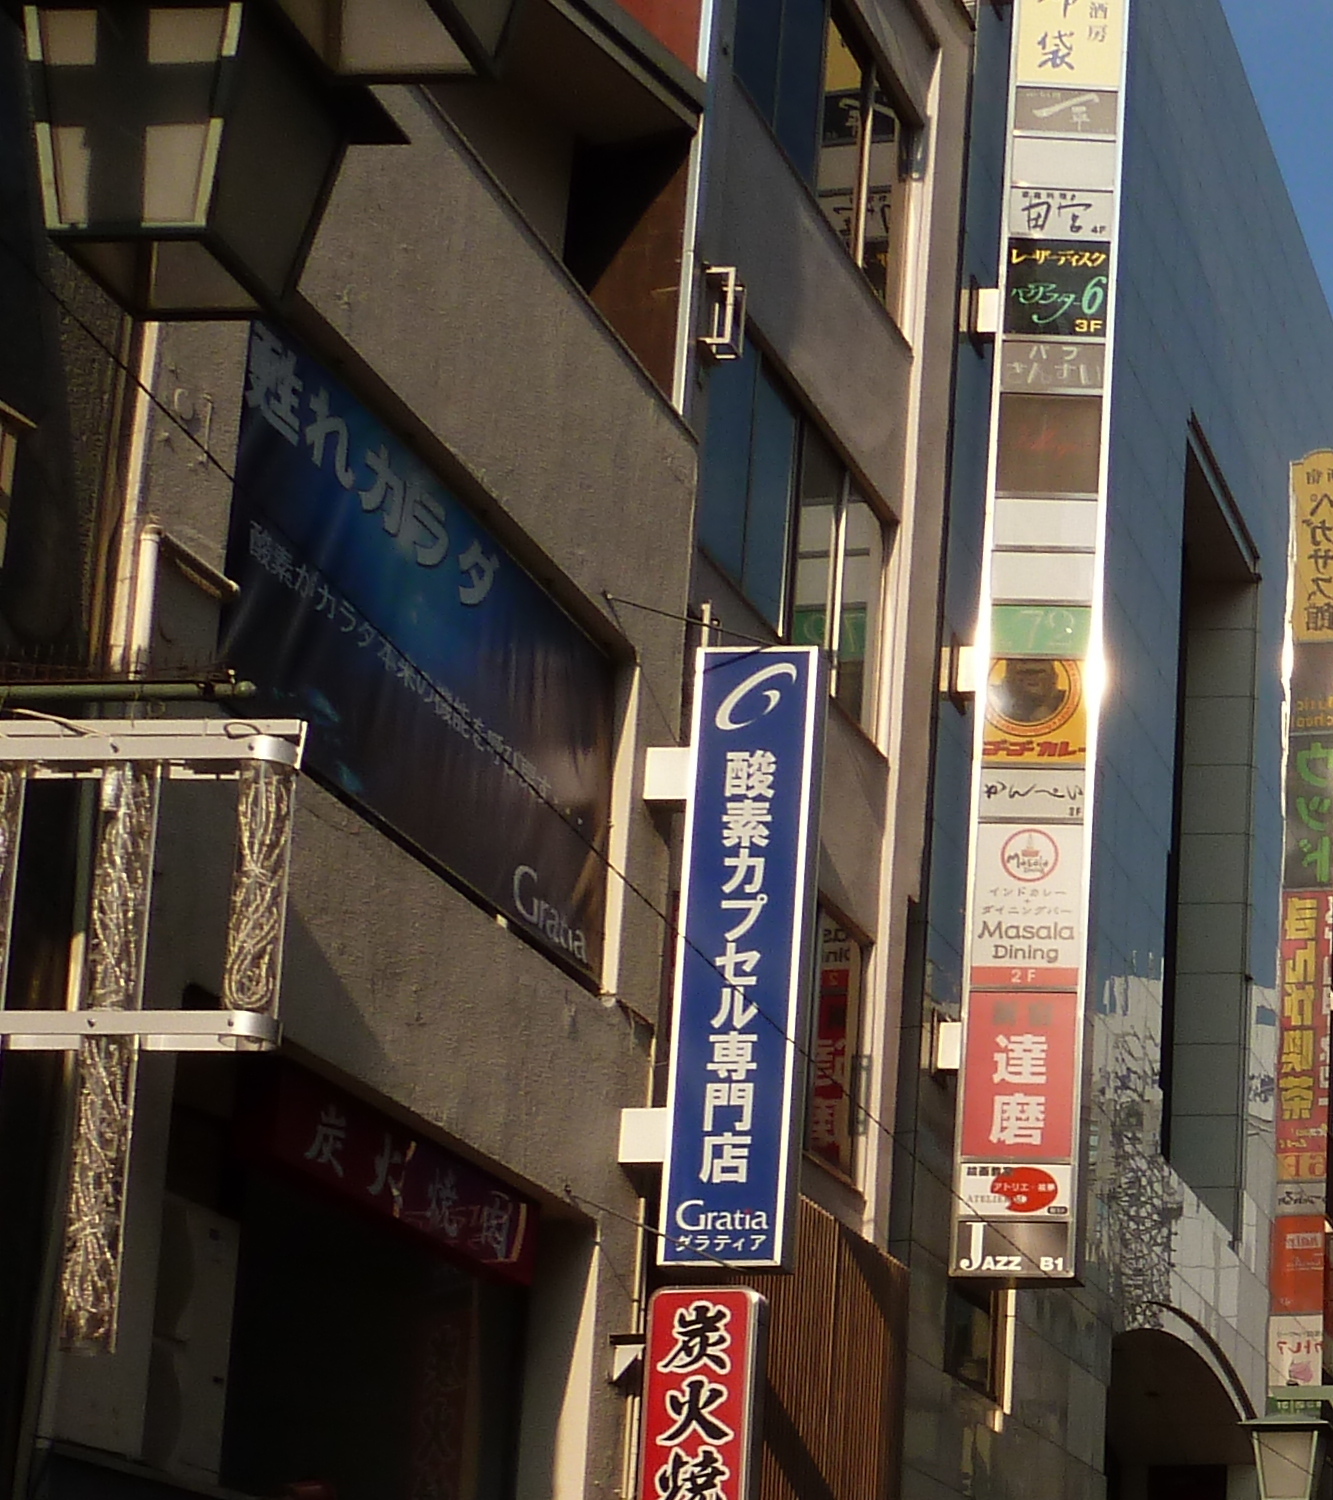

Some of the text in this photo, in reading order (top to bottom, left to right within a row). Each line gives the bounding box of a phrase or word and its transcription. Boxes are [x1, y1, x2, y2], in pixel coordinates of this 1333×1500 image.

[1074, 319, 1103, 332] 3F
[990, 887, 1066, 897] インドカレー
[982, 905, 1072, 915] ダイニングバー
[978, 920, 1074, 940] Masala
[992, 944, 1059, 963] Dining
[698, 750, 777, 1185] 酸素カプセル専門店
[989, 1034, 1048, 1146] 達磨
[675, 1200, 769, 1232] Gratia
[675, 1234, 768, 1253] グラティア
[960, 1221, 1064, 1272] JAZZ B1
